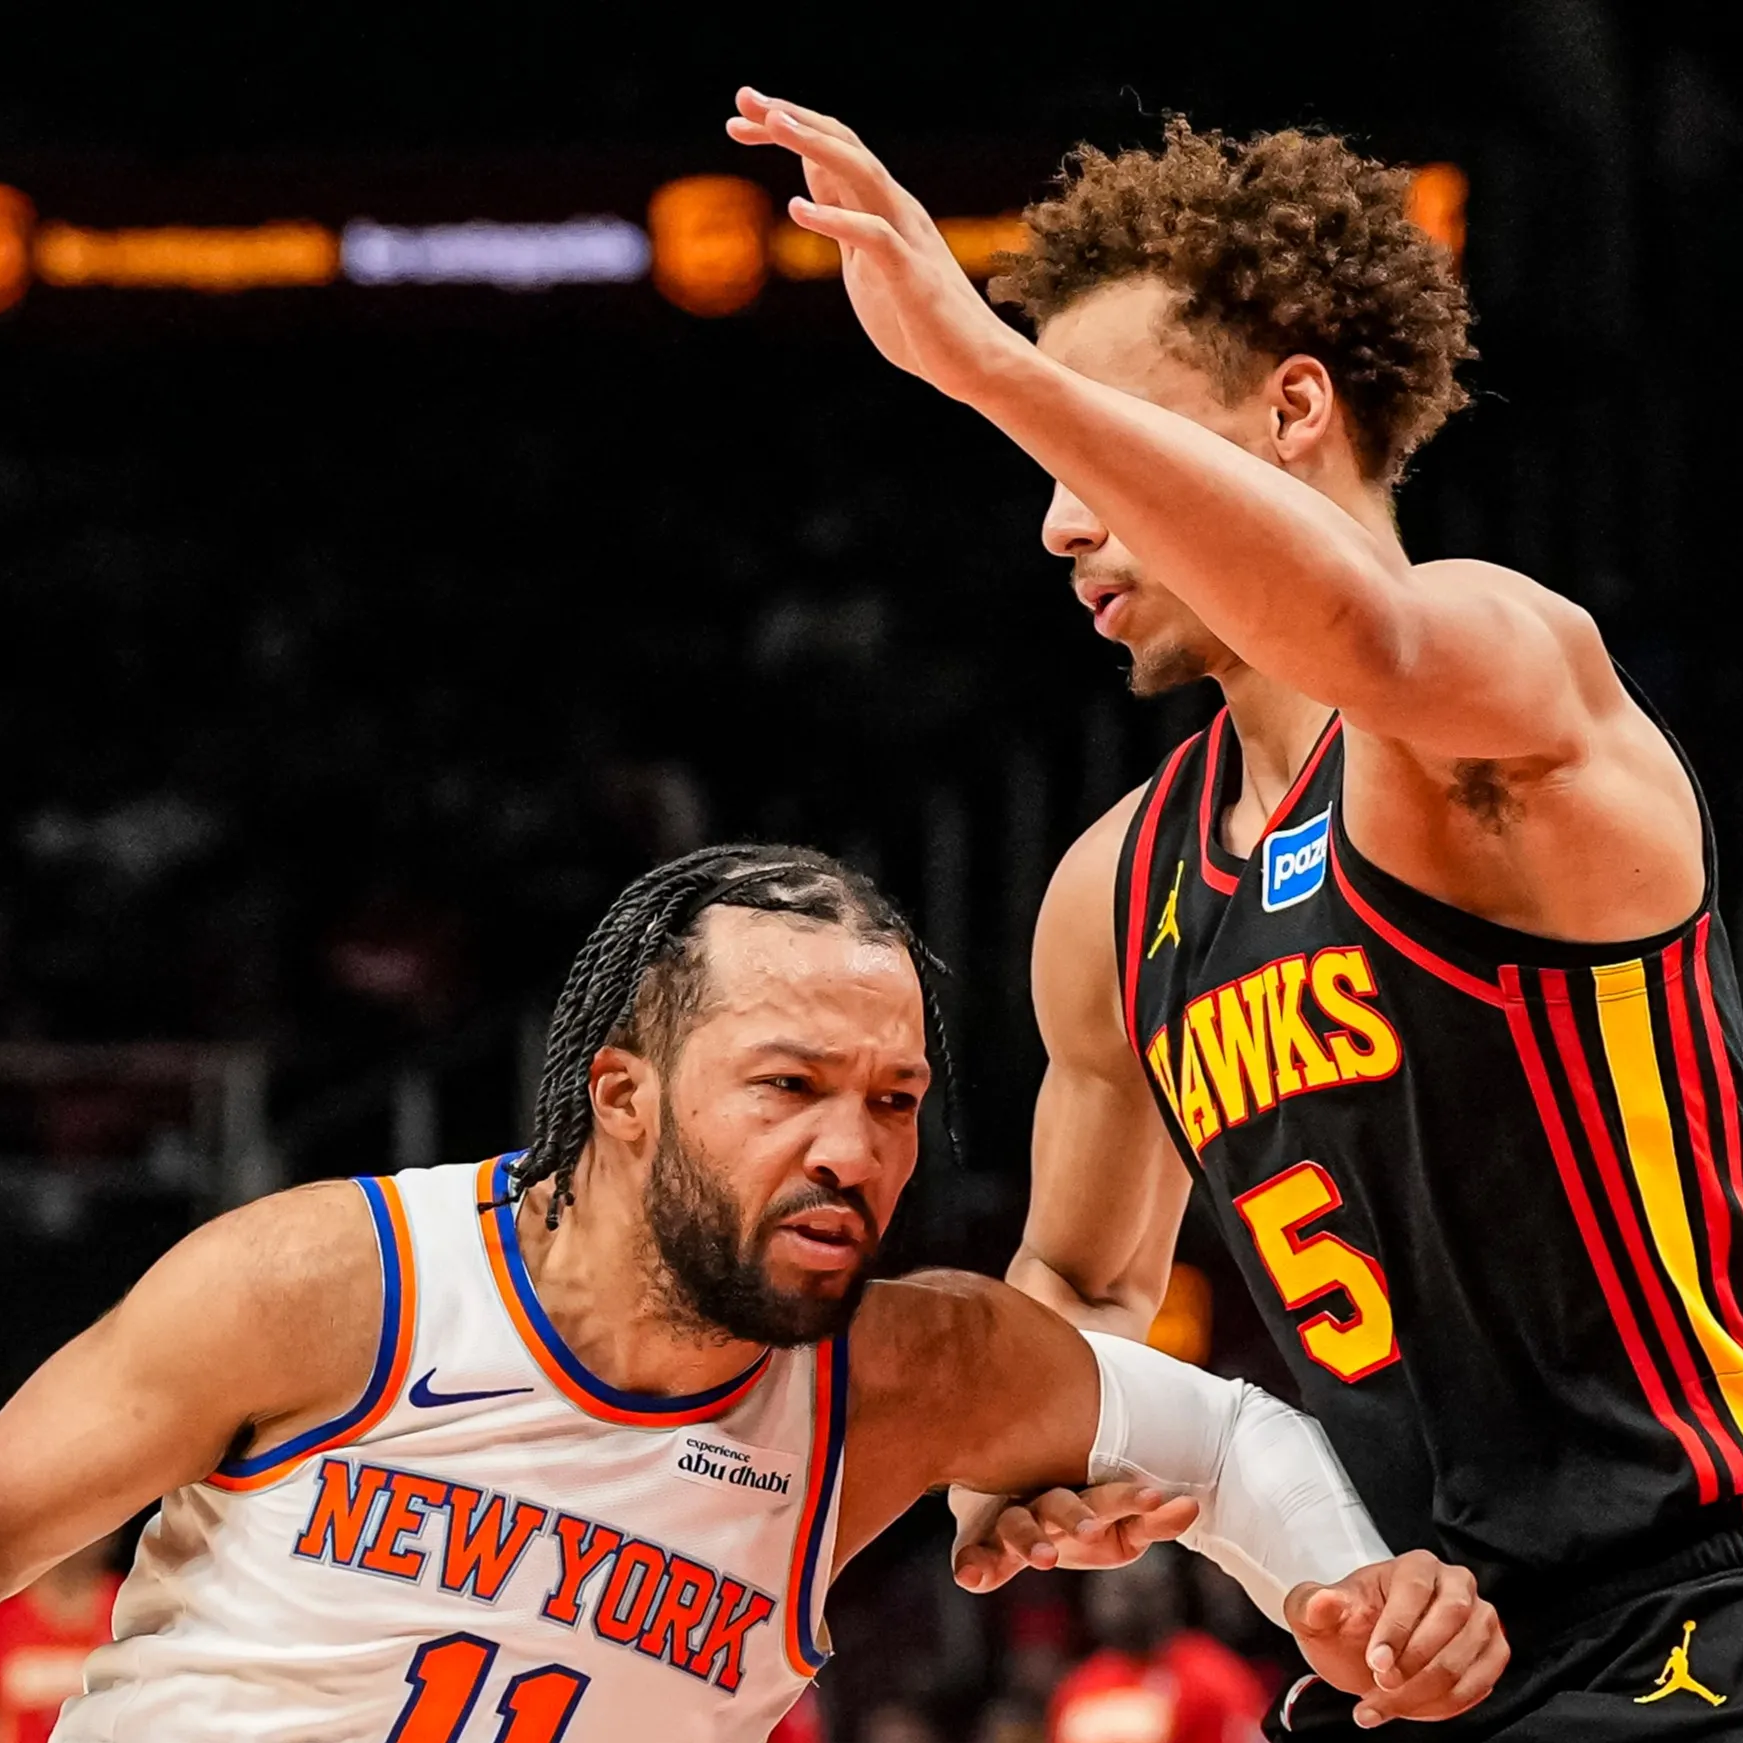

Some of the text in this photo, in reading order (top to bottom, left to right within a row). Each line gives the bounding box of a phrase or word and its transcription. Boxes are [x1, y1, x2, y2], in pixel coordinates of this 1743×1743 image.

[1233, 1161, 1402, 1384] 5
[678, 1453, 792, 1495] abu dhabi
[686, 1438, 751, 1463] experience
[291, 1456, 778, 1697] NEW YORK
